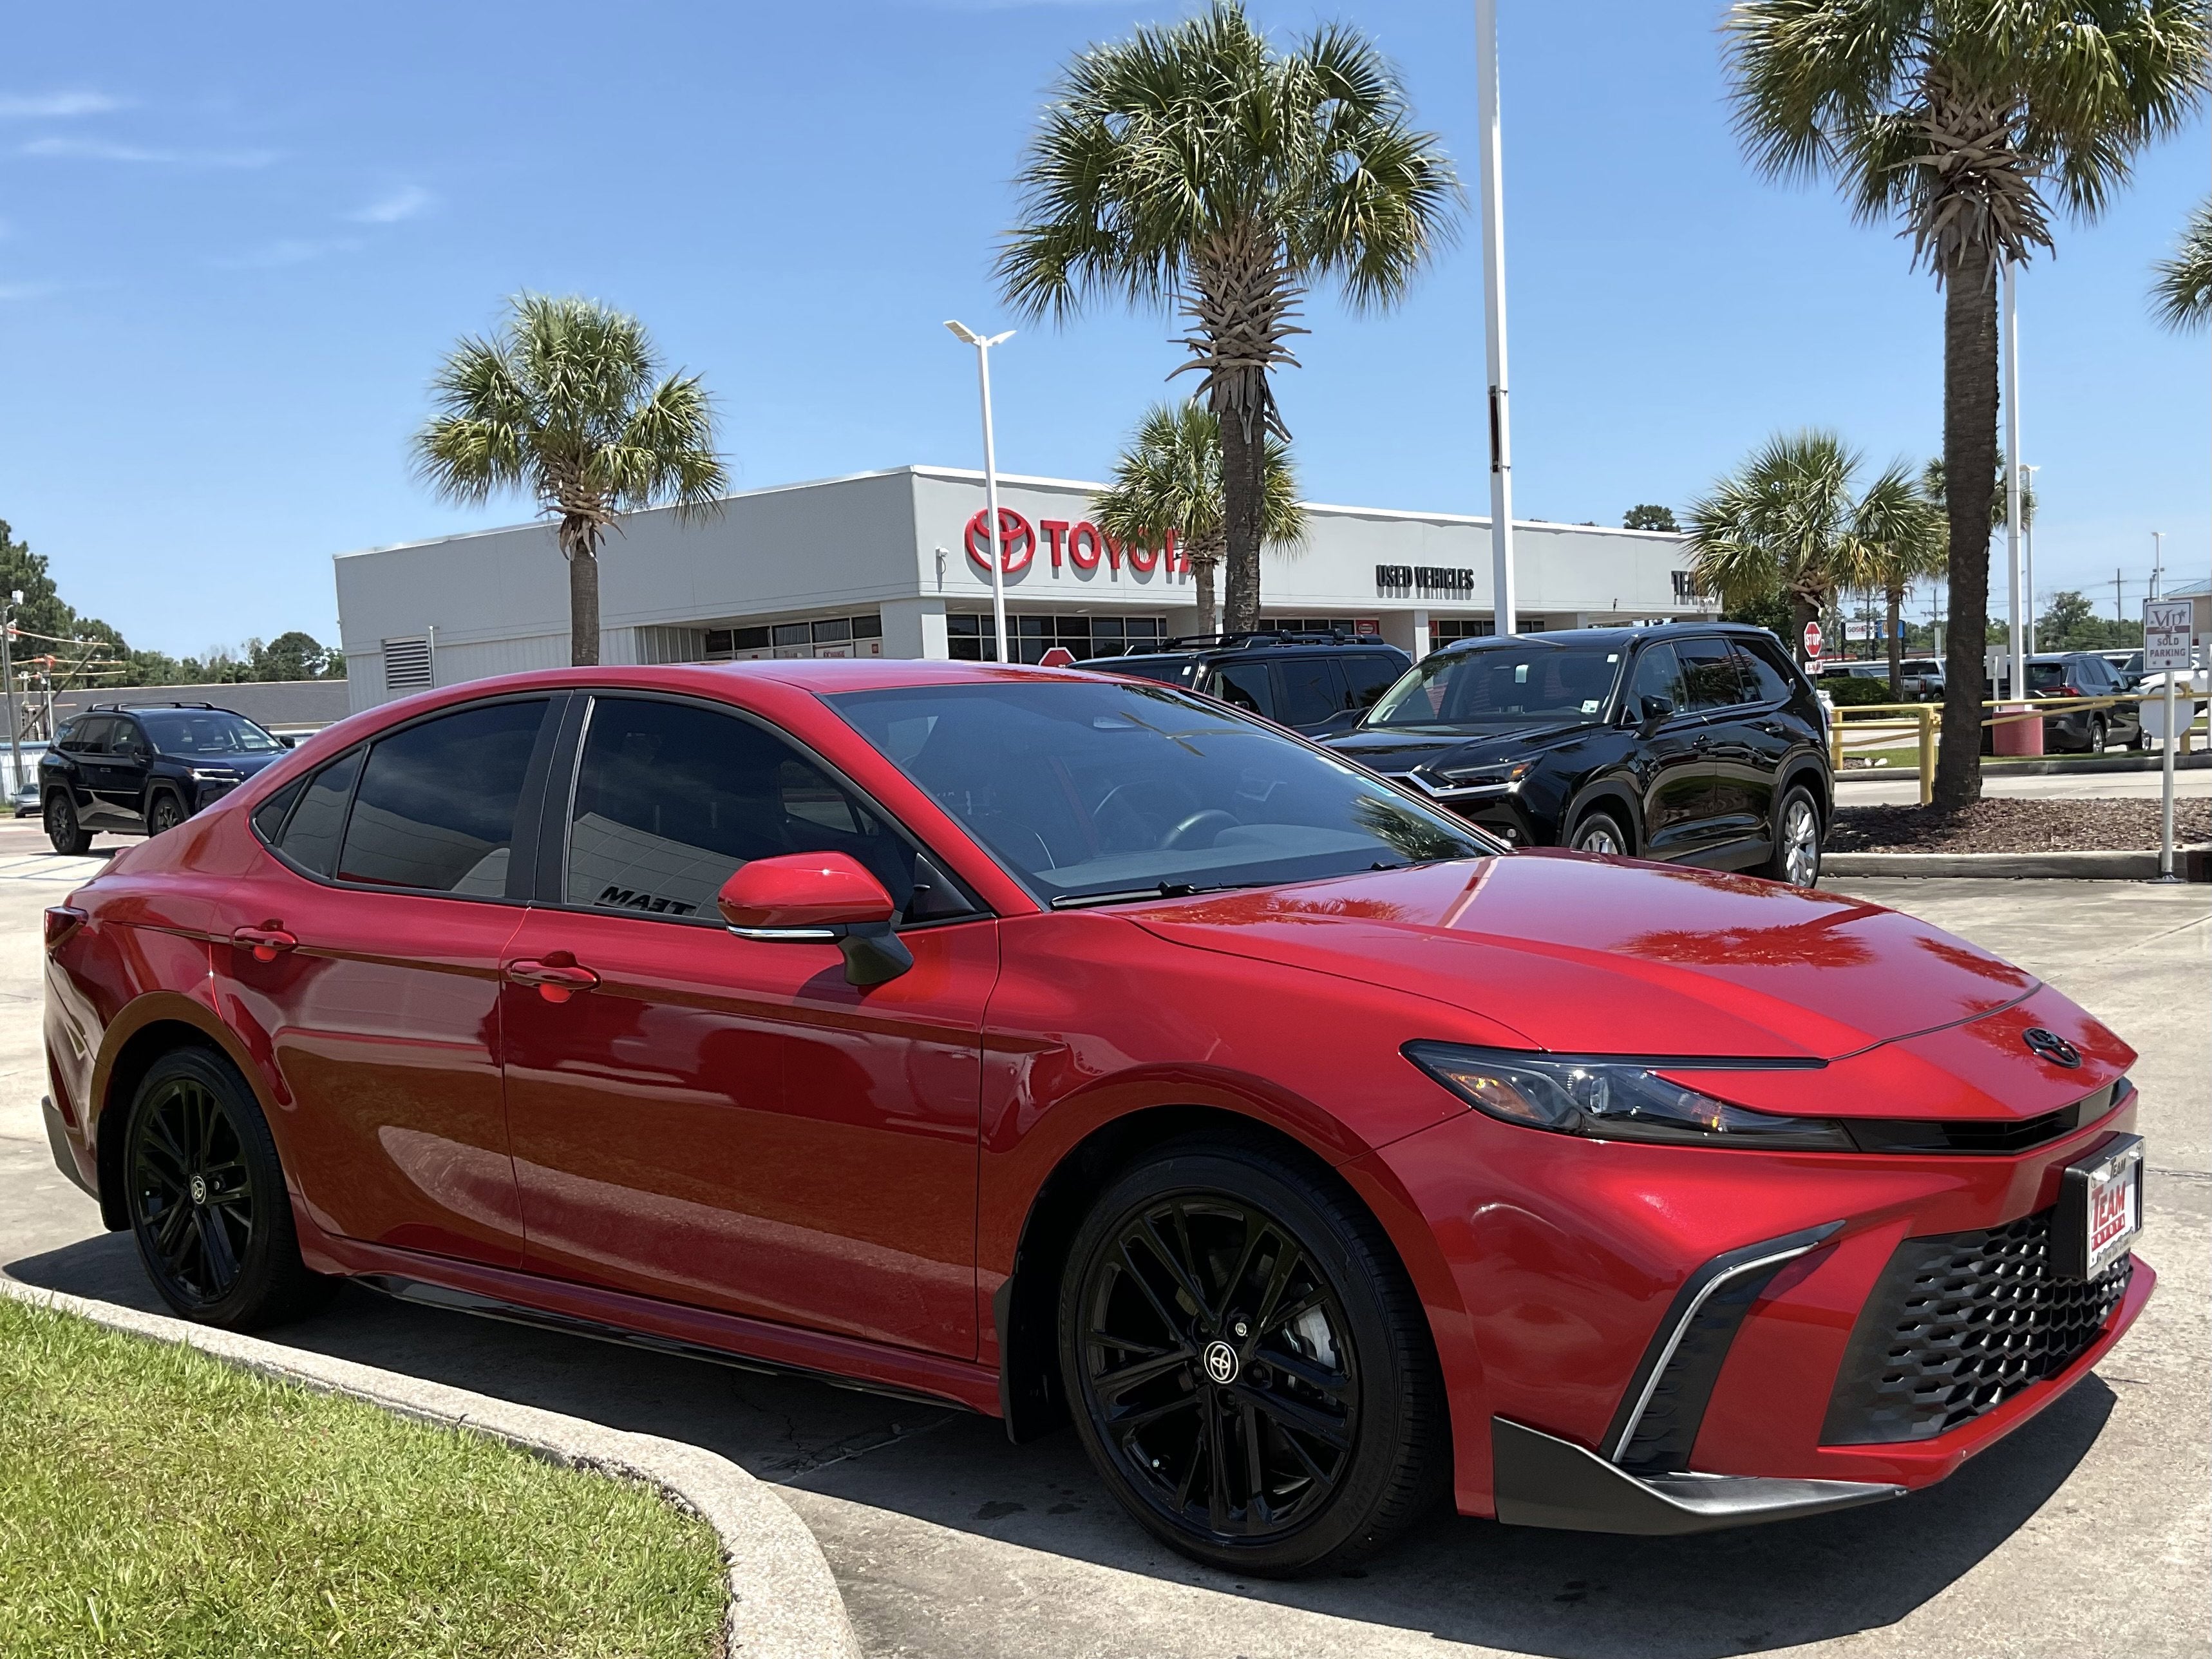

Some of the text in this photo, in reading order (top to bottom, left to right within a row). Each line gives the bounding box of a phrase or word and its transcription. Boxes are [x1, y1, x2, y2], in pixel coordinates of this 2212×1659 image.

[1040, 519, 1190, 573] TOYOT
[1375, 565, 1474, 590] USED VEHICLES
[1806, 634, 1820, 646] STOP
[2150, 649, 2186, 657] PARKING
[2107, 1156, 2126, 1183] TEAM
[2092, 1180, 2126, 1233] TEAM
[2092, 1216, 2124, 1248] TOYOTA
